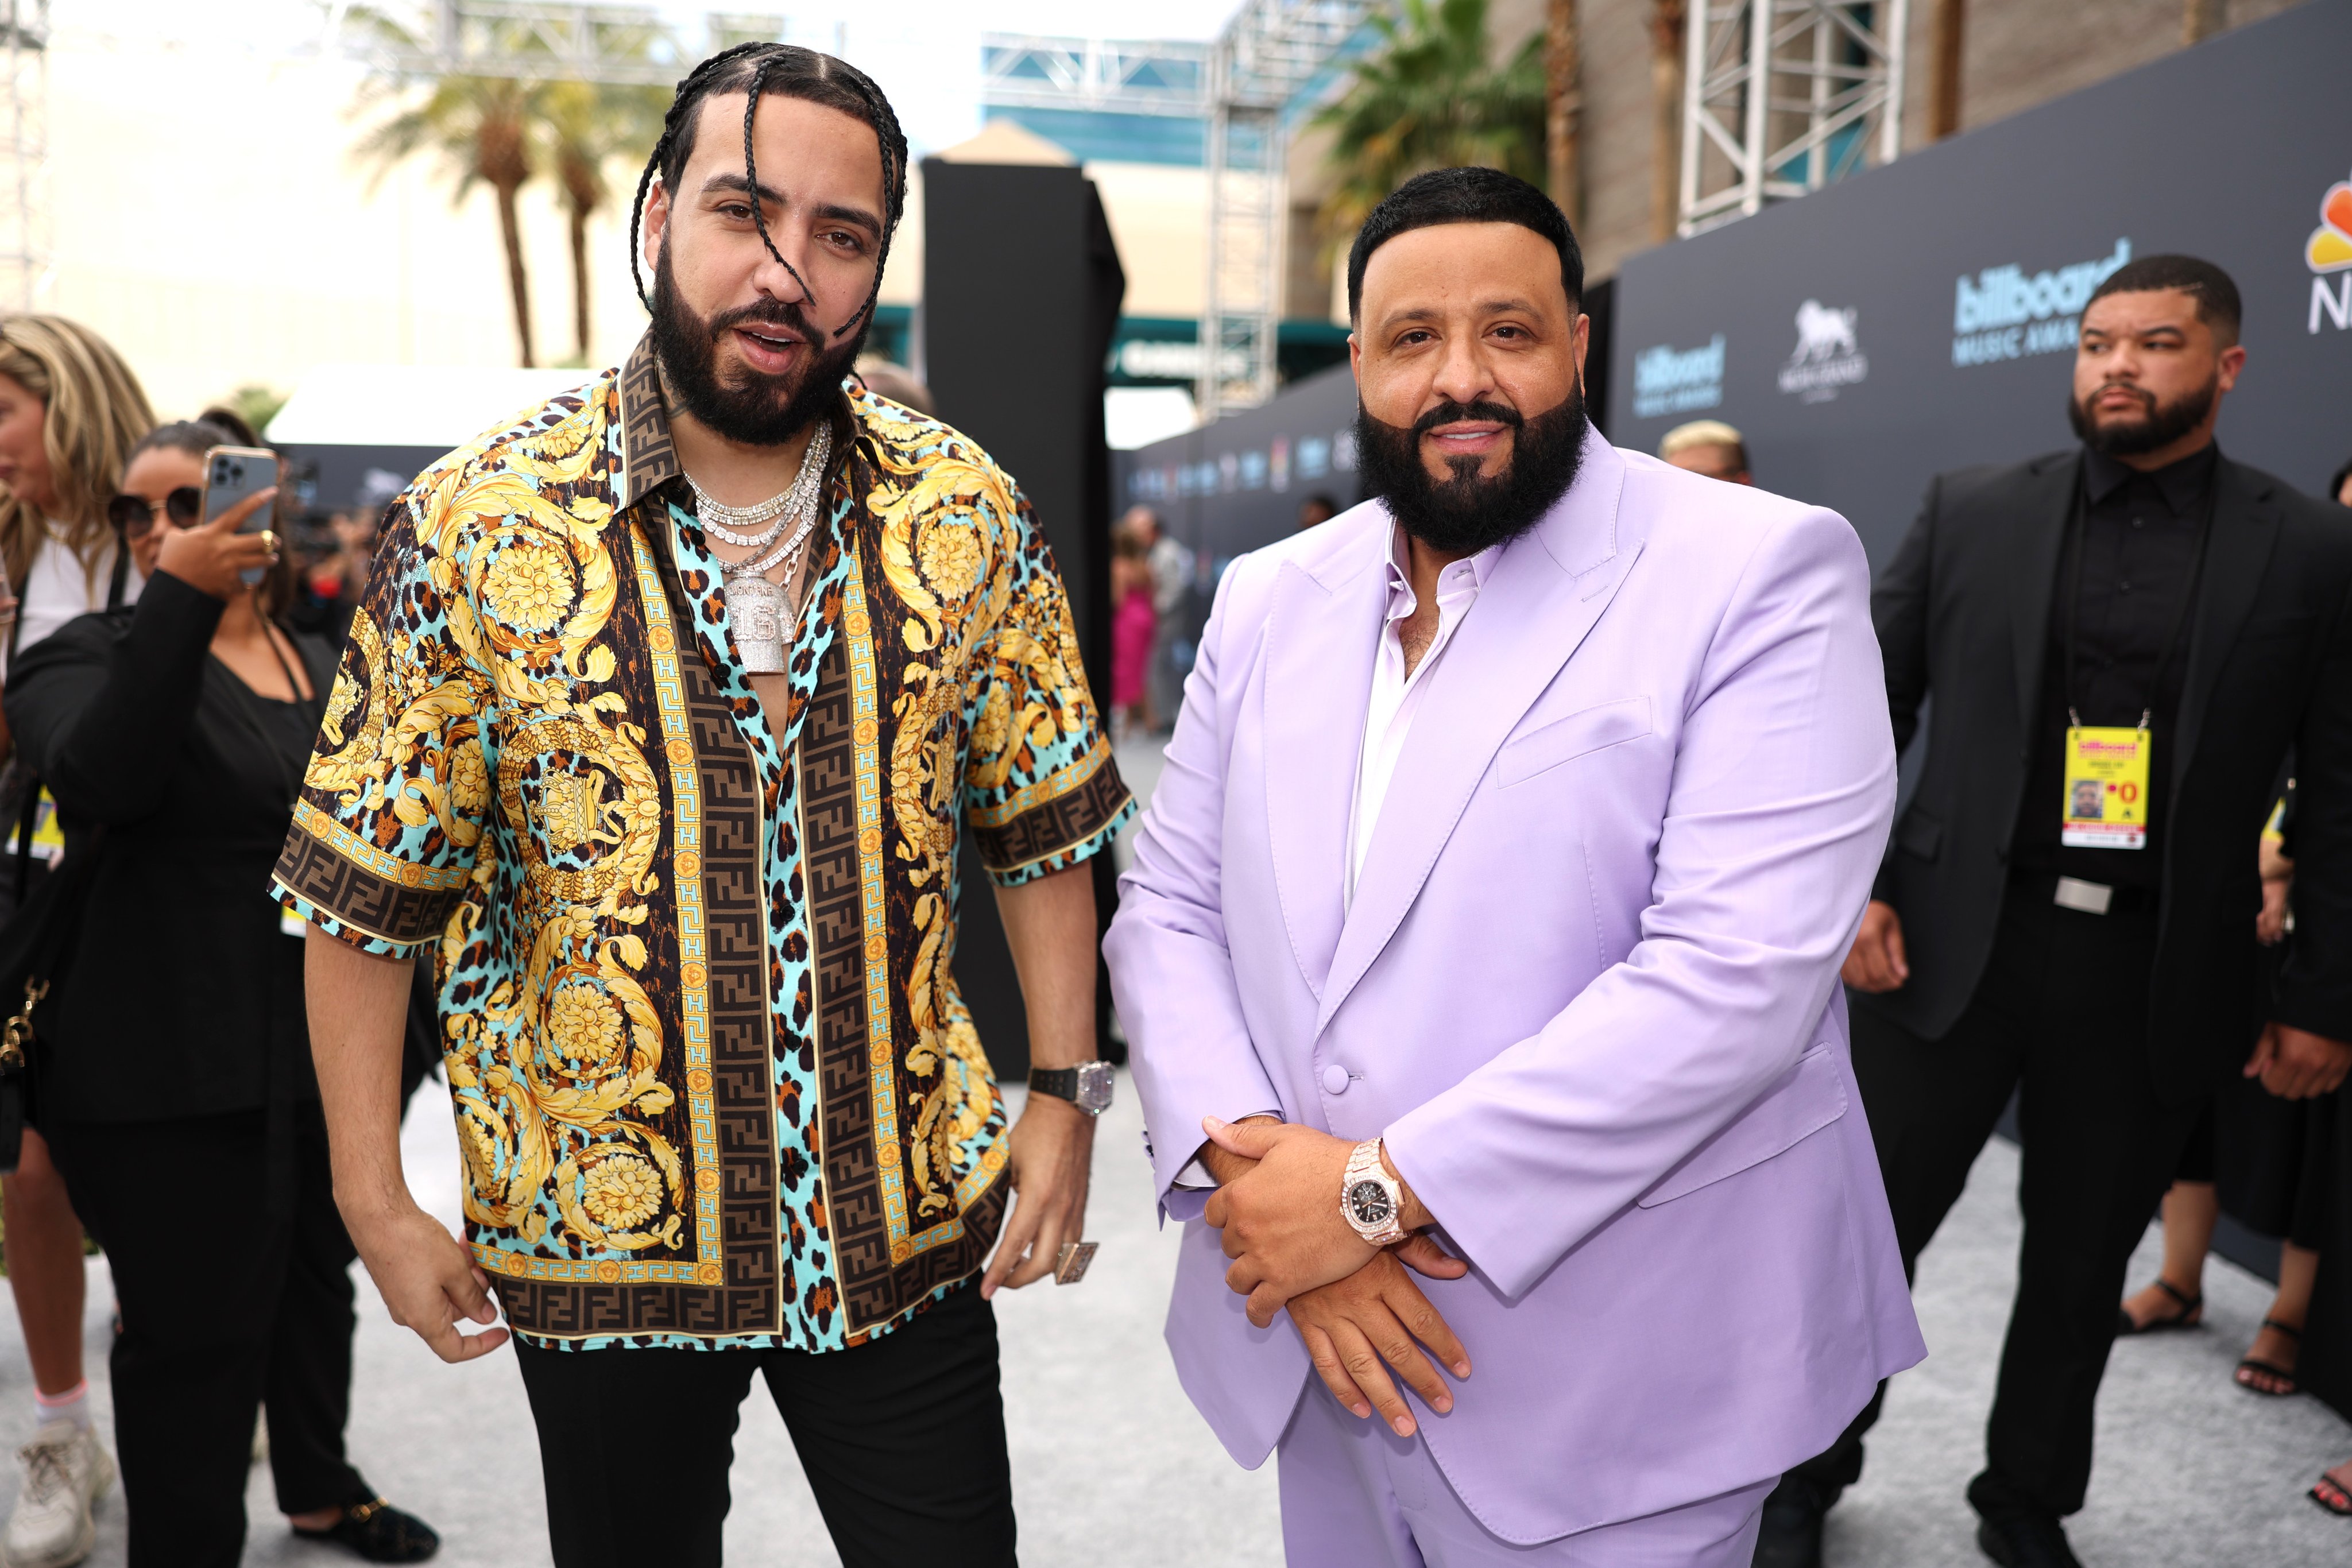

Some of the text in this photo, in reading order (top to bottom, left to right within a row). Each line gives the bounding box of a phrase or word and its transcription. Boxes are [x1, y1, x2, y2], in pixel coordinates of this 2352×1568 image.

[1951, 317, 2080, 369] MUSIC AWA
[733, 606, 775, 640] 16
